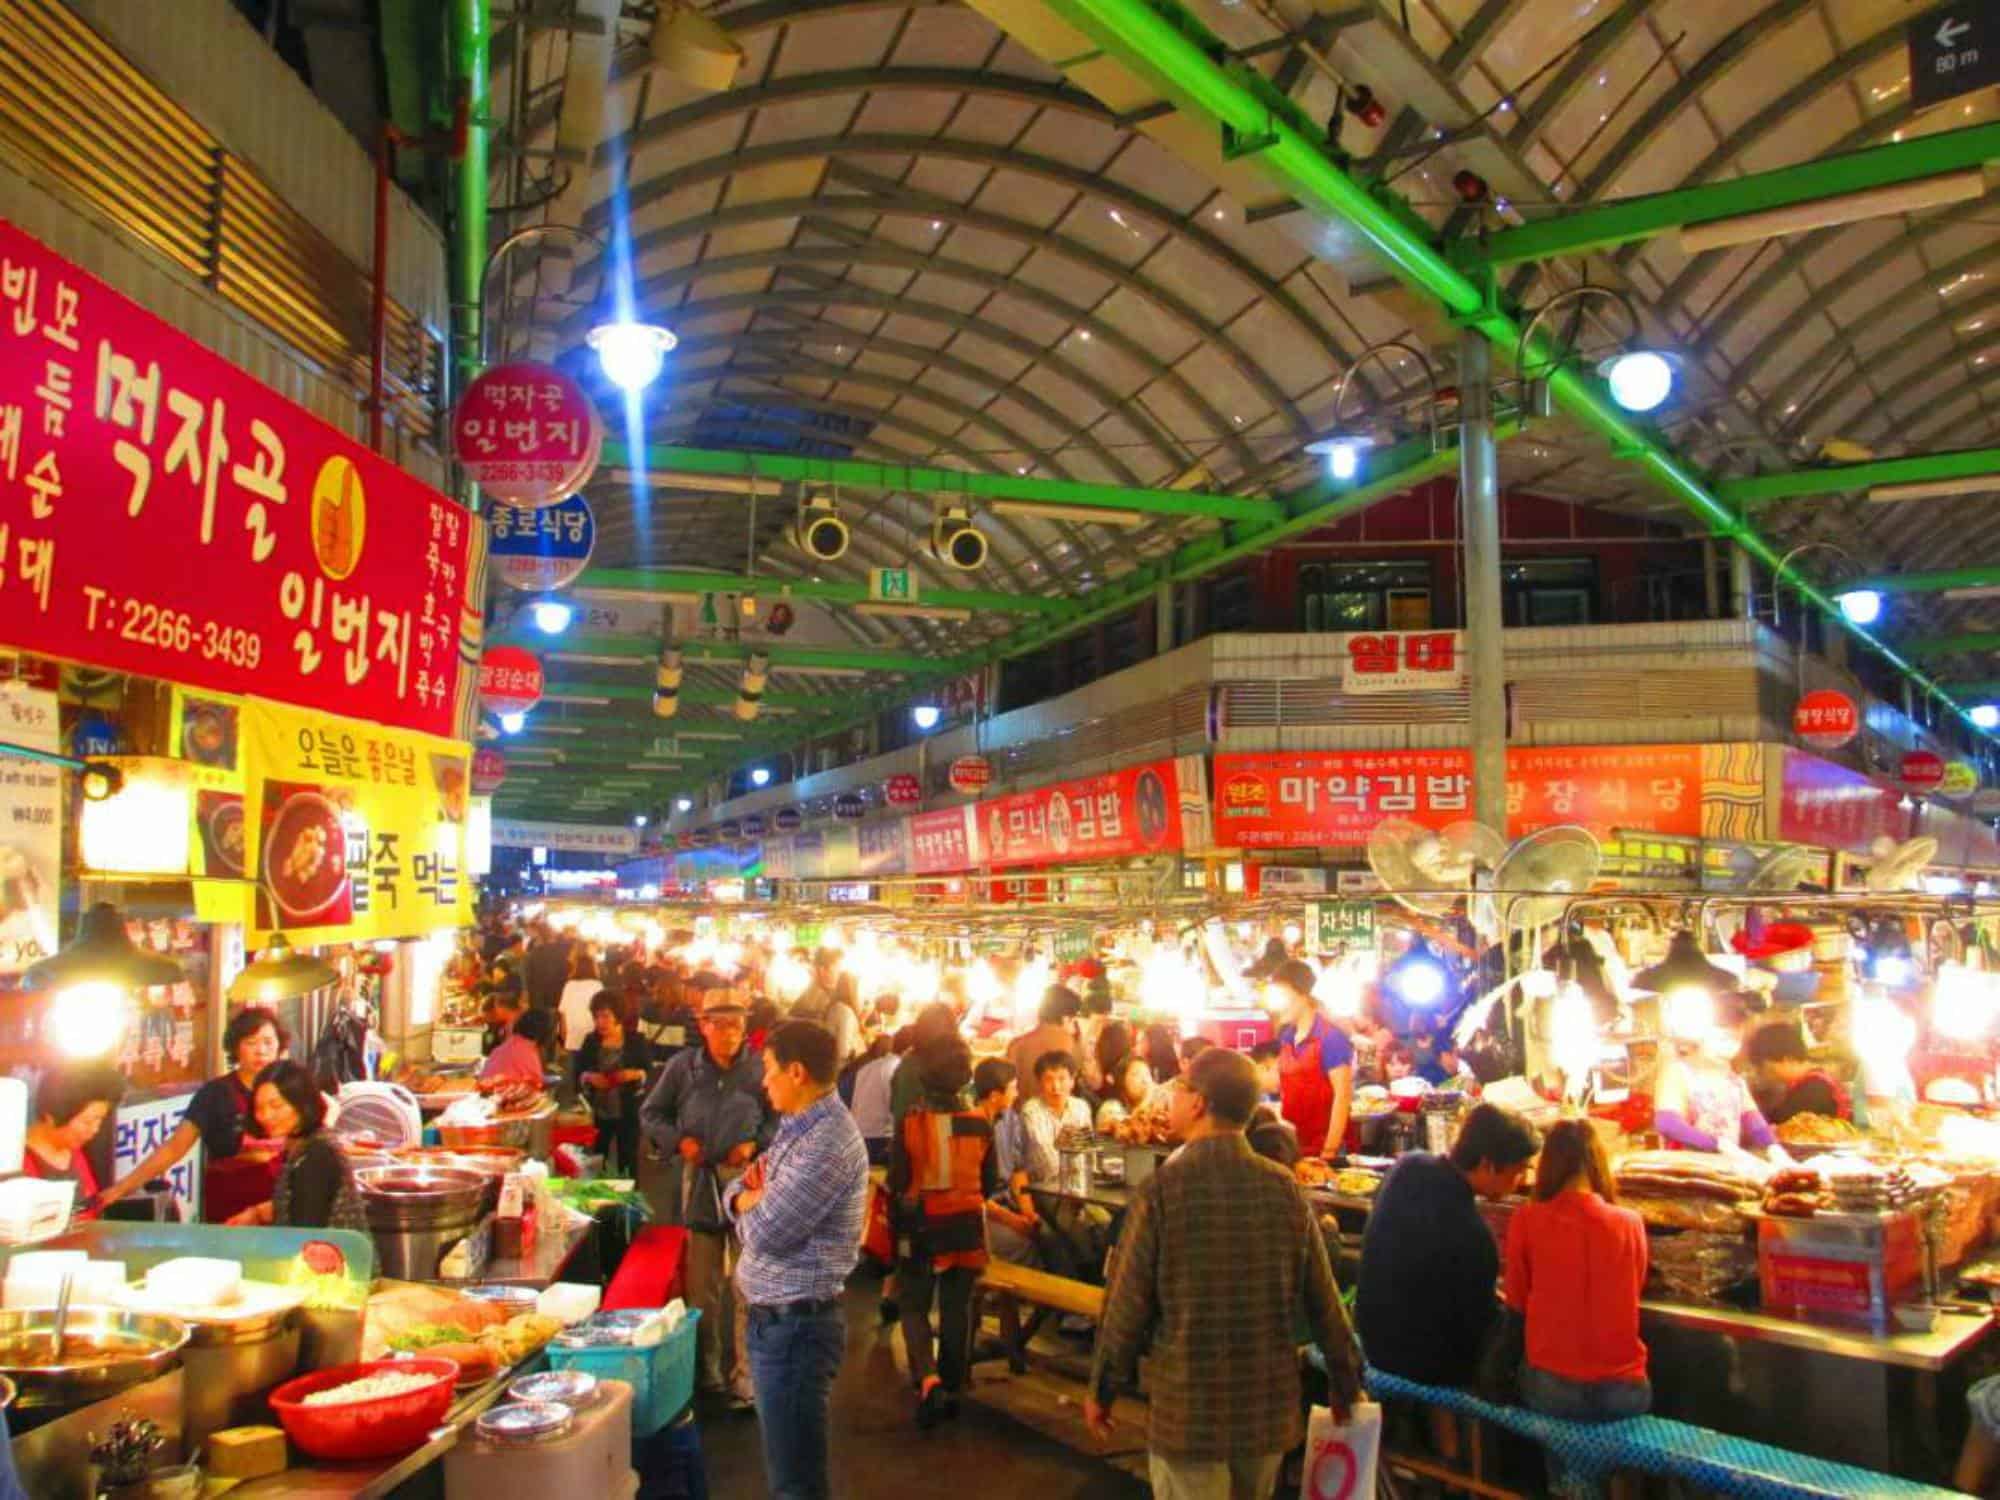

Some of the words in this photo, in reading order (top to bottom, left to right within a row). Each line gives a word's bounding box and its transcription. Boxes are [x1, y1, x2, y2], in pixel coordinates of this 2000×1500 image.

[95, 338, 288, 562] 먹자골
[464, 419, 580, 455] 일번지
[491, 506, 587, 543] 종로식당
[279, 573, 410, 698] 일번지
[298, 727, 365, 779] 오늘은
[1073, 790, 1121, 839] 김밥
[1280, 773, 1471, 814] 마약김밥
